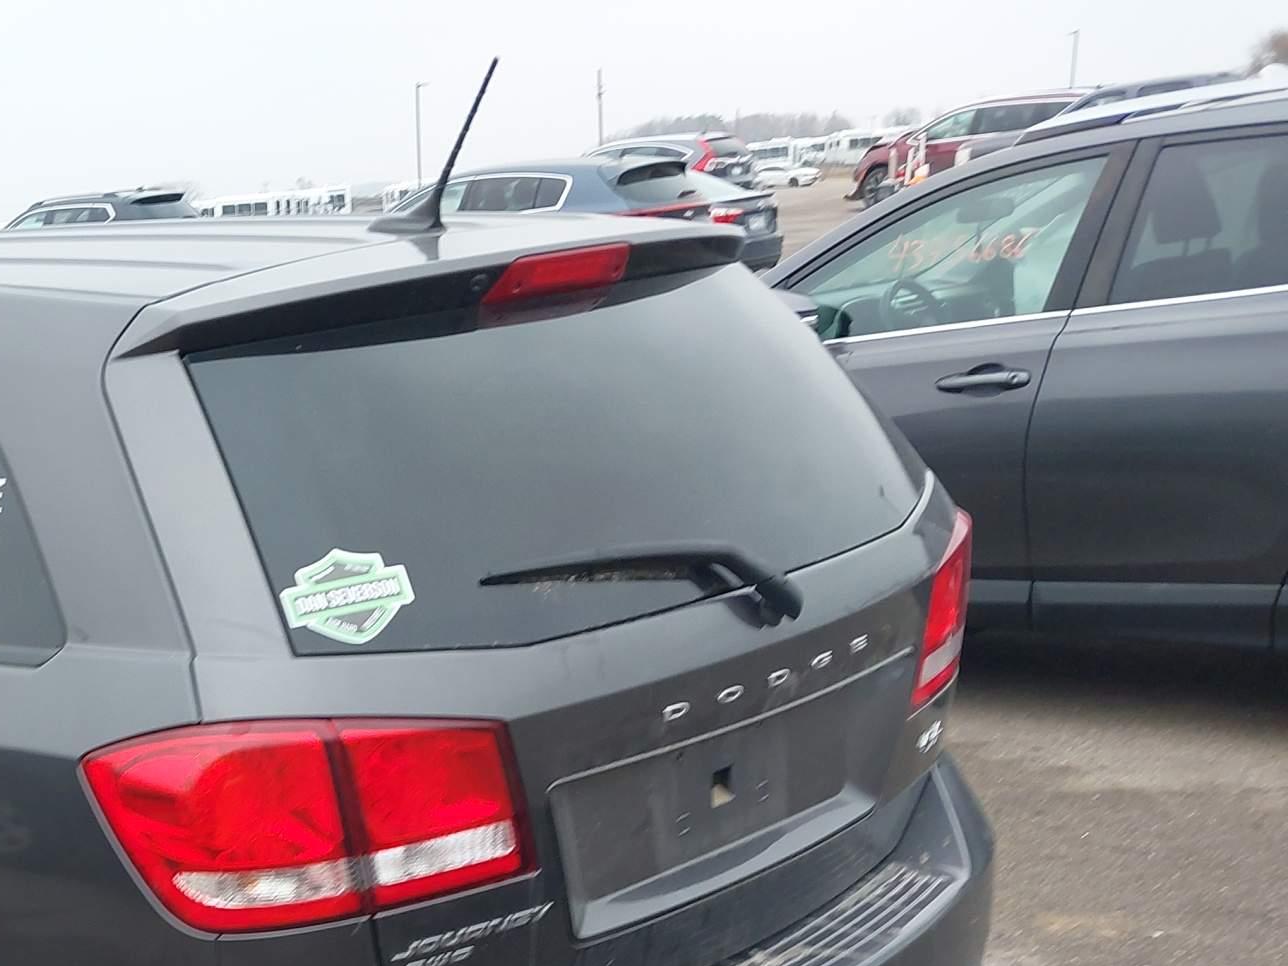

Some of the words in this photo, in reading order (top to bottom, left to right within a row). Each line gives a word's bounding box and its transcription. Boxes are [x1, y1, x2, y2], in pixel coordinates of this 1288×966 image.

[326, 577, 401, 608] SEVERSON
[662, 633, 869, 722] DODGE
[390, 900, 555, 963] JOURNEY
